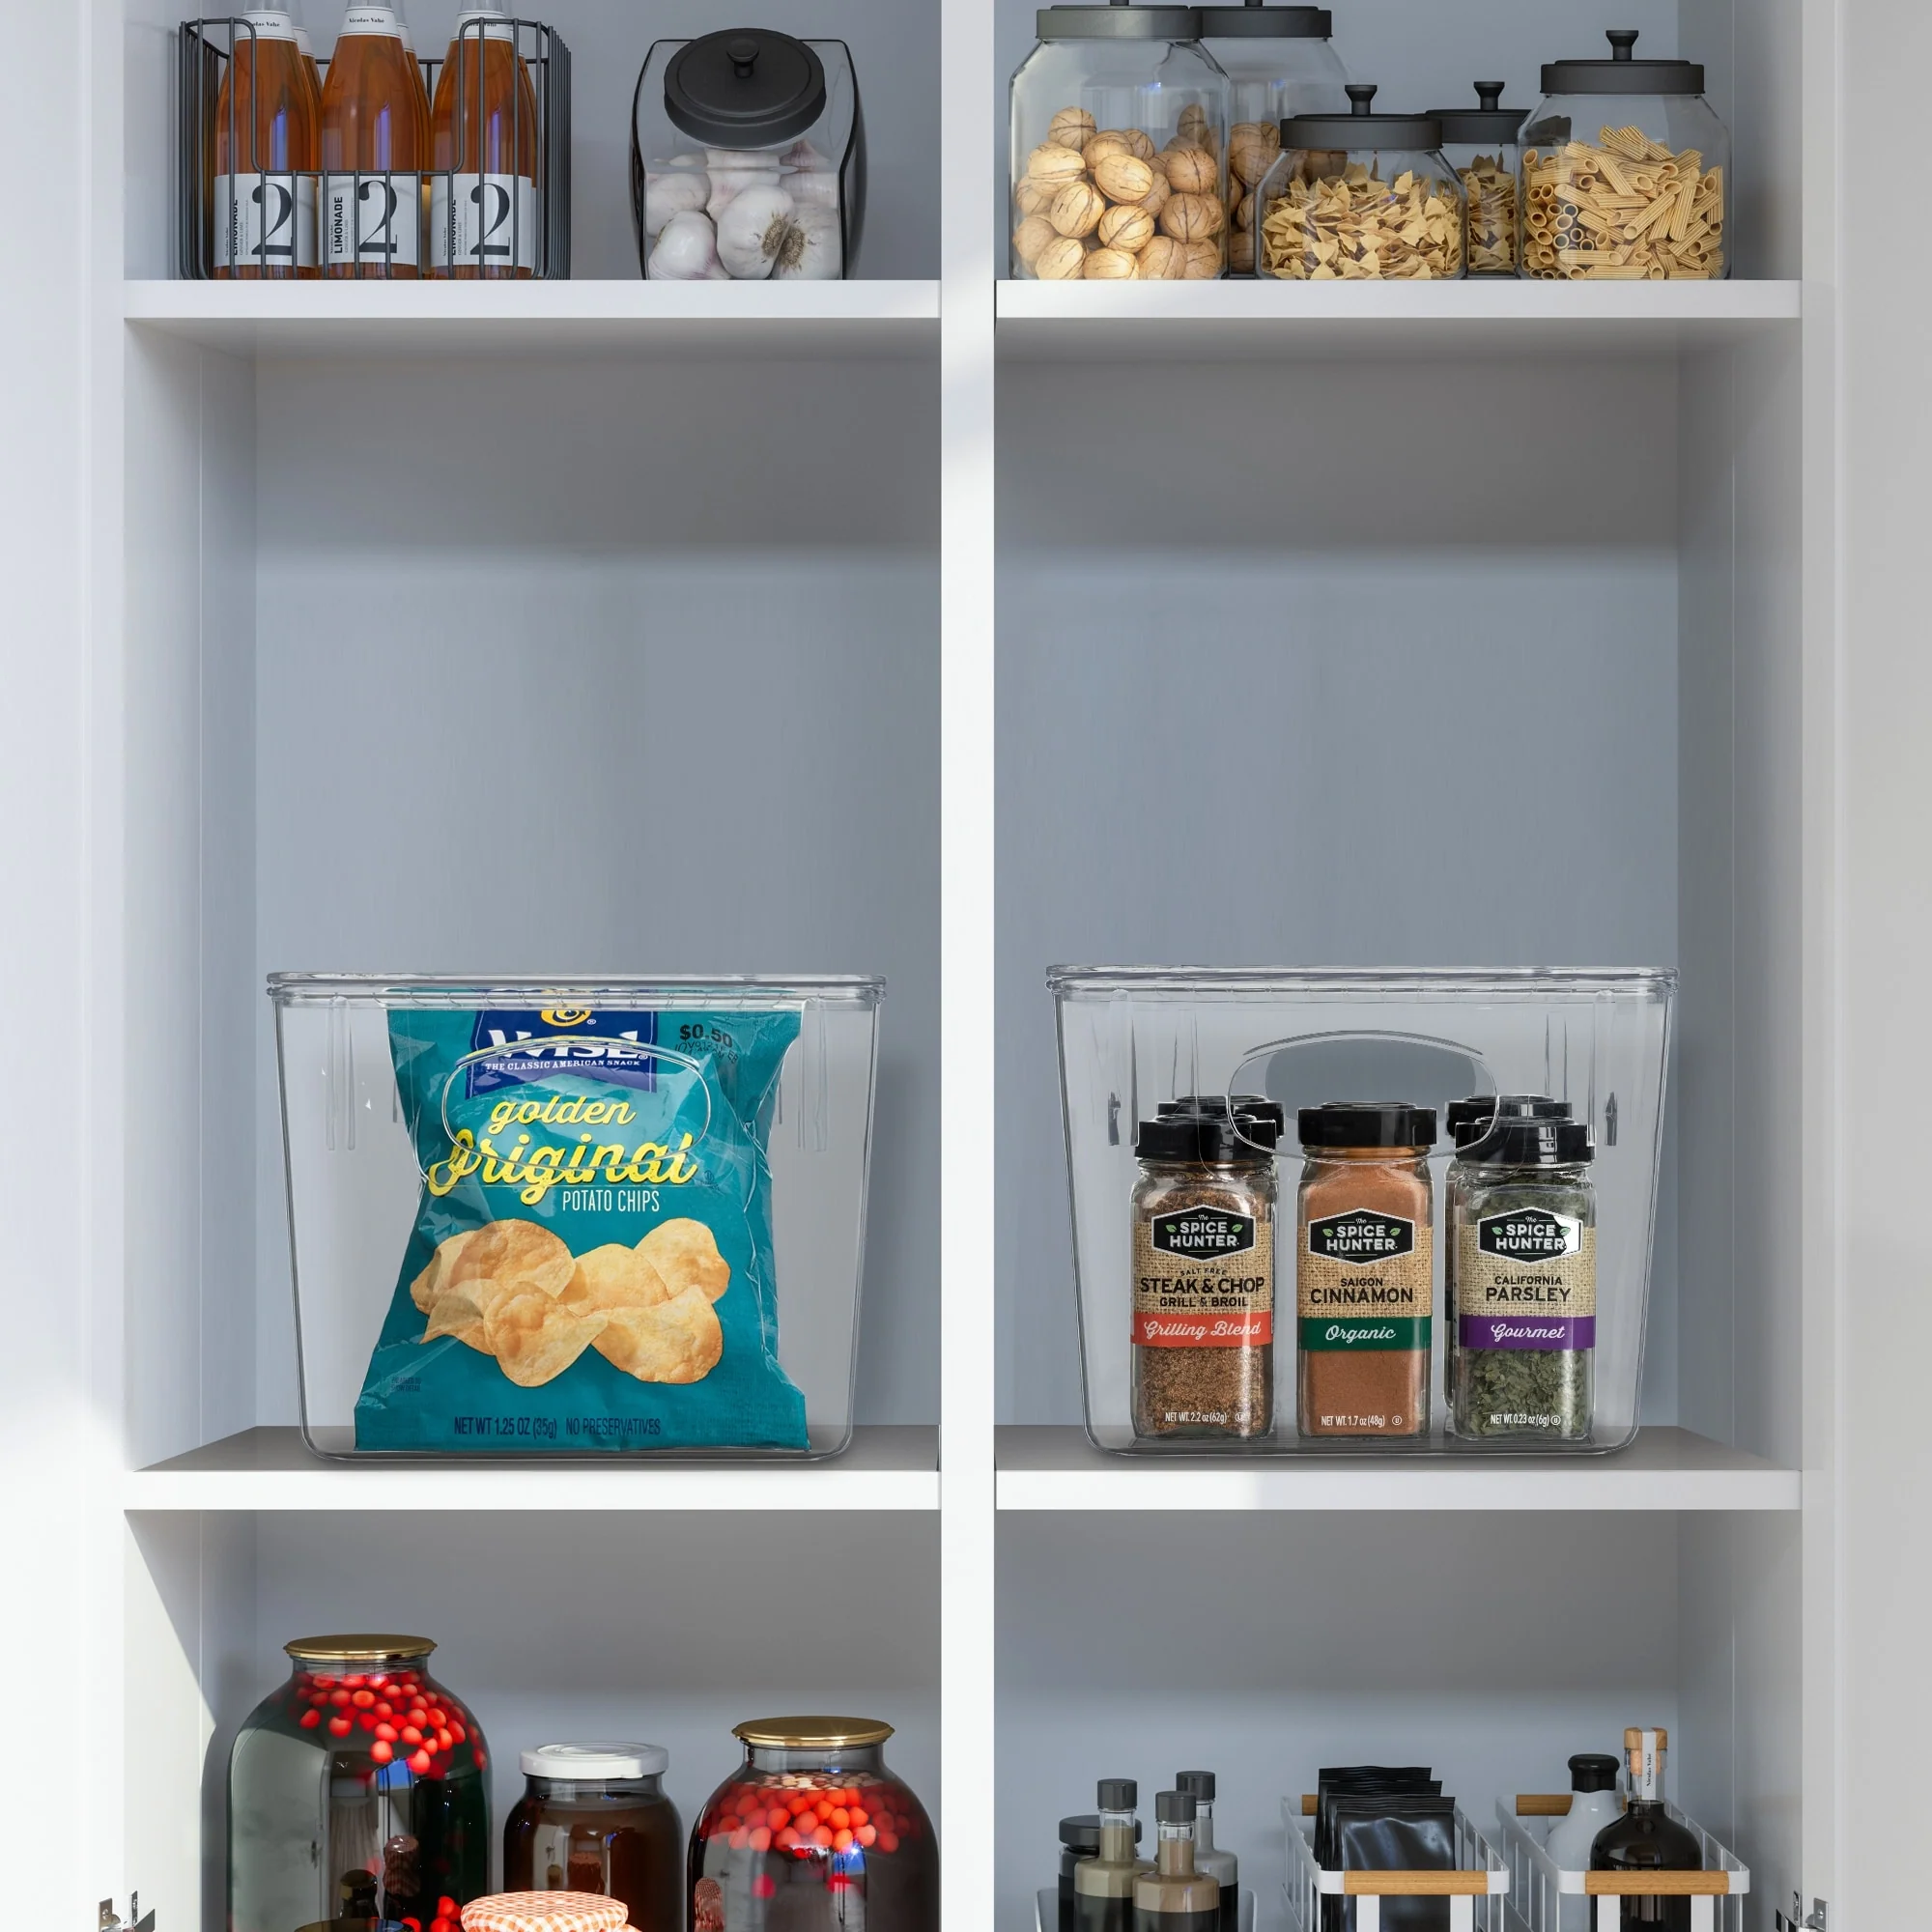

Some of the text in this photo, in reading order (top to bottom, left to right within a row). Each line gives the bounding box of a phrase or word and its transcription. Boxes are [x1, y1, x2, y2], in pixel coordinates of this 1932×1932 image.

[251, 183, 292, 255] 2
[334, 196, 343, 254] LIMONADE
[357, 181, 397, 253] 2
[470, 183, 510, 256] 2
[679, 1024, 733, 1048] $0.50
[507, 1061, 551, 1070] CLASSIC
[553, 1060, 605, 1068] AMERICAN
[488, 1095, 636, 1135] golden
[428, 1128, 697, 1205] Original
[562, 1190, 661, 1212] POTATO CHIPS
[1179, 1221, 1228, 1234] SPICE
[1336, 1225, 1386, 1237] SPICE
[1506, 1224, 1555, 1236] SPICE
[1180, 1267, 1201, 1276] SALT
[1140, 1276, 1264, 1293] STEAK & CHOP
[1340, 1277, 1383, 1287] SAIGON
[1494, 1275, 1563, 1286] CALIFORNIA
[1159, 1296, 1249, 1308] GRILL & BROIL
[1310, 1288, 1413, 1304] CINNAMON
[1486, 1287, 1571, 1302] PARSLEY
[1143, 1321, 1262, 1341] Grilling Blend
[1324, 1324, 1397, 1344] Organic
[1491, 1322, 1566, 1343] Gourmet
[1165, 1412, 1178, 1422] NET
[1178, 1412, 1189, 1422] WT.
[1190, 1412, 1201, 1422] 2.2
[1209, 1412, 1227, 1425] (62g)
[1321, 1415, 1334, 1426] NET
[1335, 1415, 1347, 1426] WT.
[1348, 1415, 1358, 1426] 1.7
[1367, 1415, 1385, 1428] (48g)
[1490, 1414, 1502, 1424] NET
[1503, 1413, 1513, 1423] WT.
[1513, 1413, 1526, 1424] 0.23
[1536, 1413, 1549, 1427] (6g)
[454, 1416, 661, 1438] NET WT 1.25 OZ (35g) NO PRESERVATIVES
